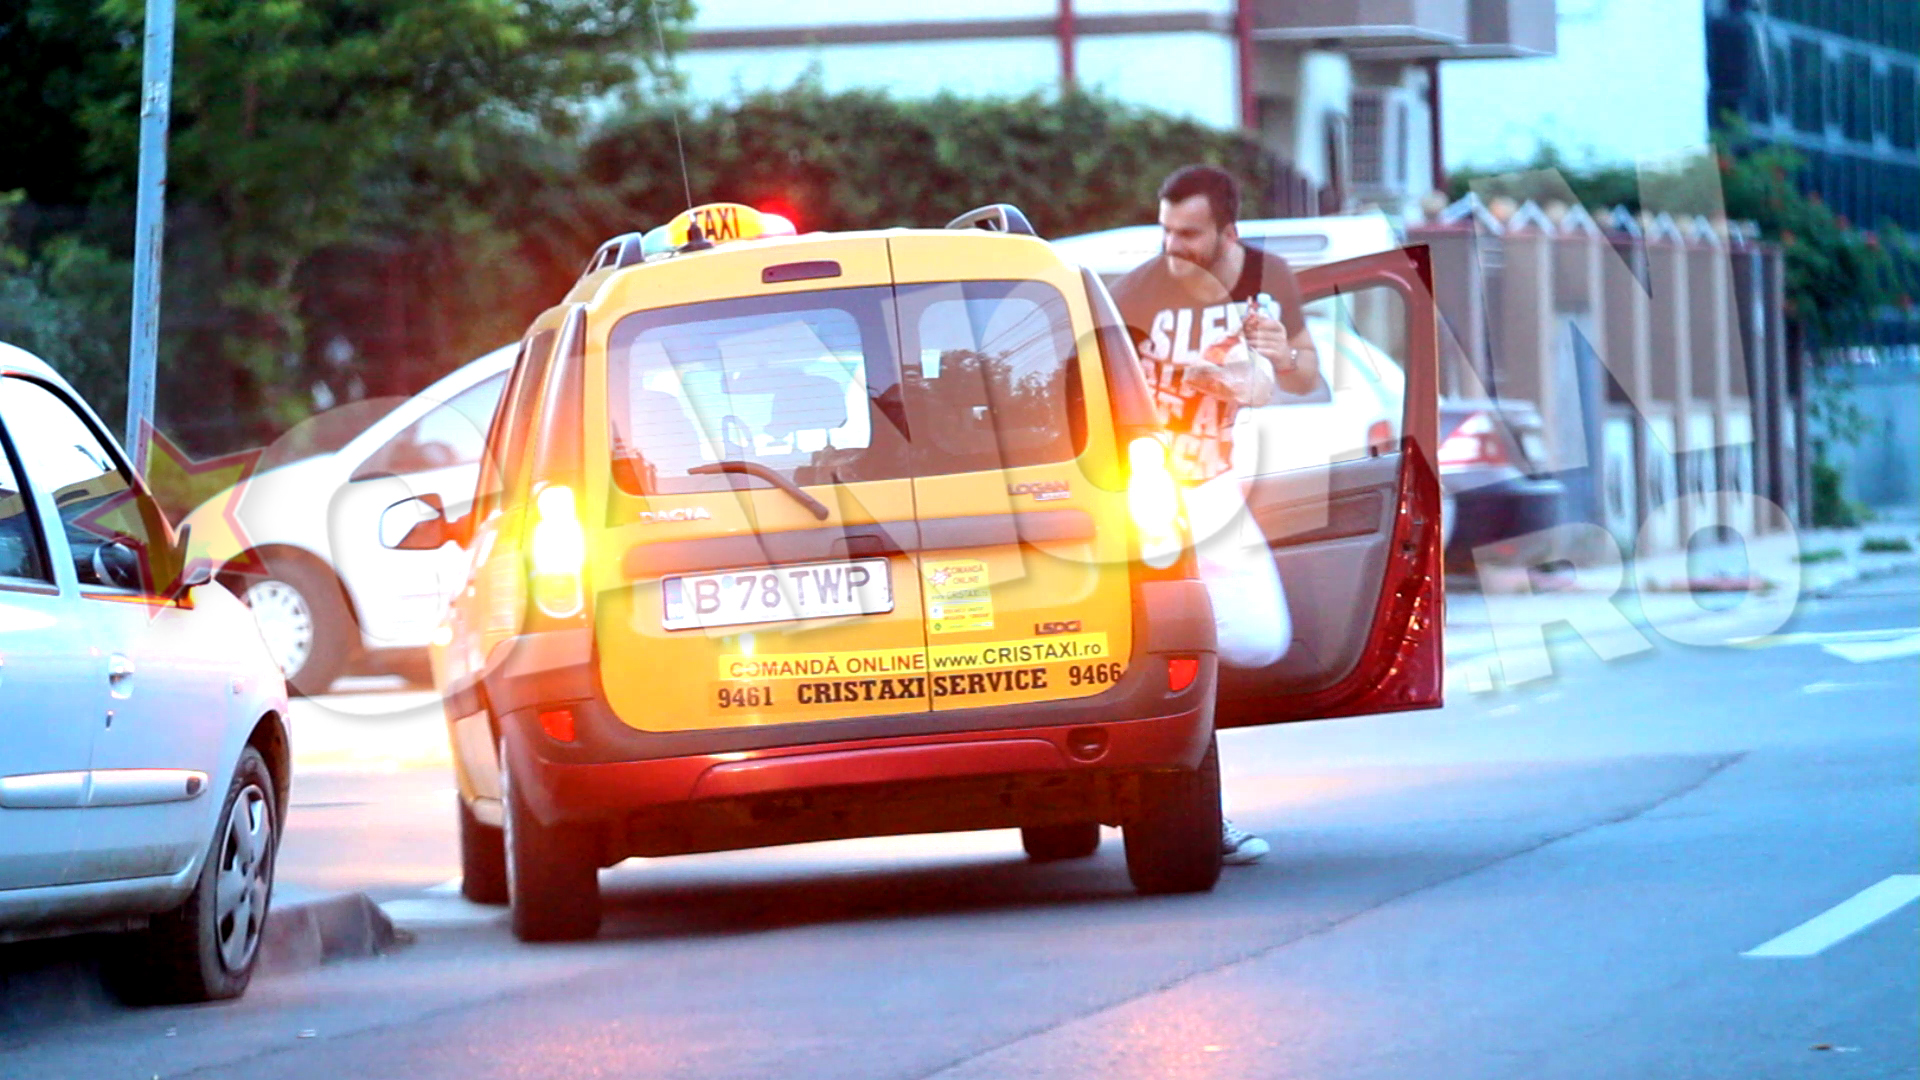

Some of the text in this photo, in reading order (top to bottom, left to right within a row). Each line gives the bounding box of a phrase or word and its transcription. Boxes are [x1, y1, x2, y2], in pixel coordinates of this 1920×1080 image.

[639, 506, 712, 524] DACIA
[694, 566, 871, 614] B 78 TWP
[729, 641, 1102, 678] COMANDĂ ONLINE www.CRISTAXI.ro
[718, 662, 1122, 708] 9461 CRISTAXI SERVICE 9466
